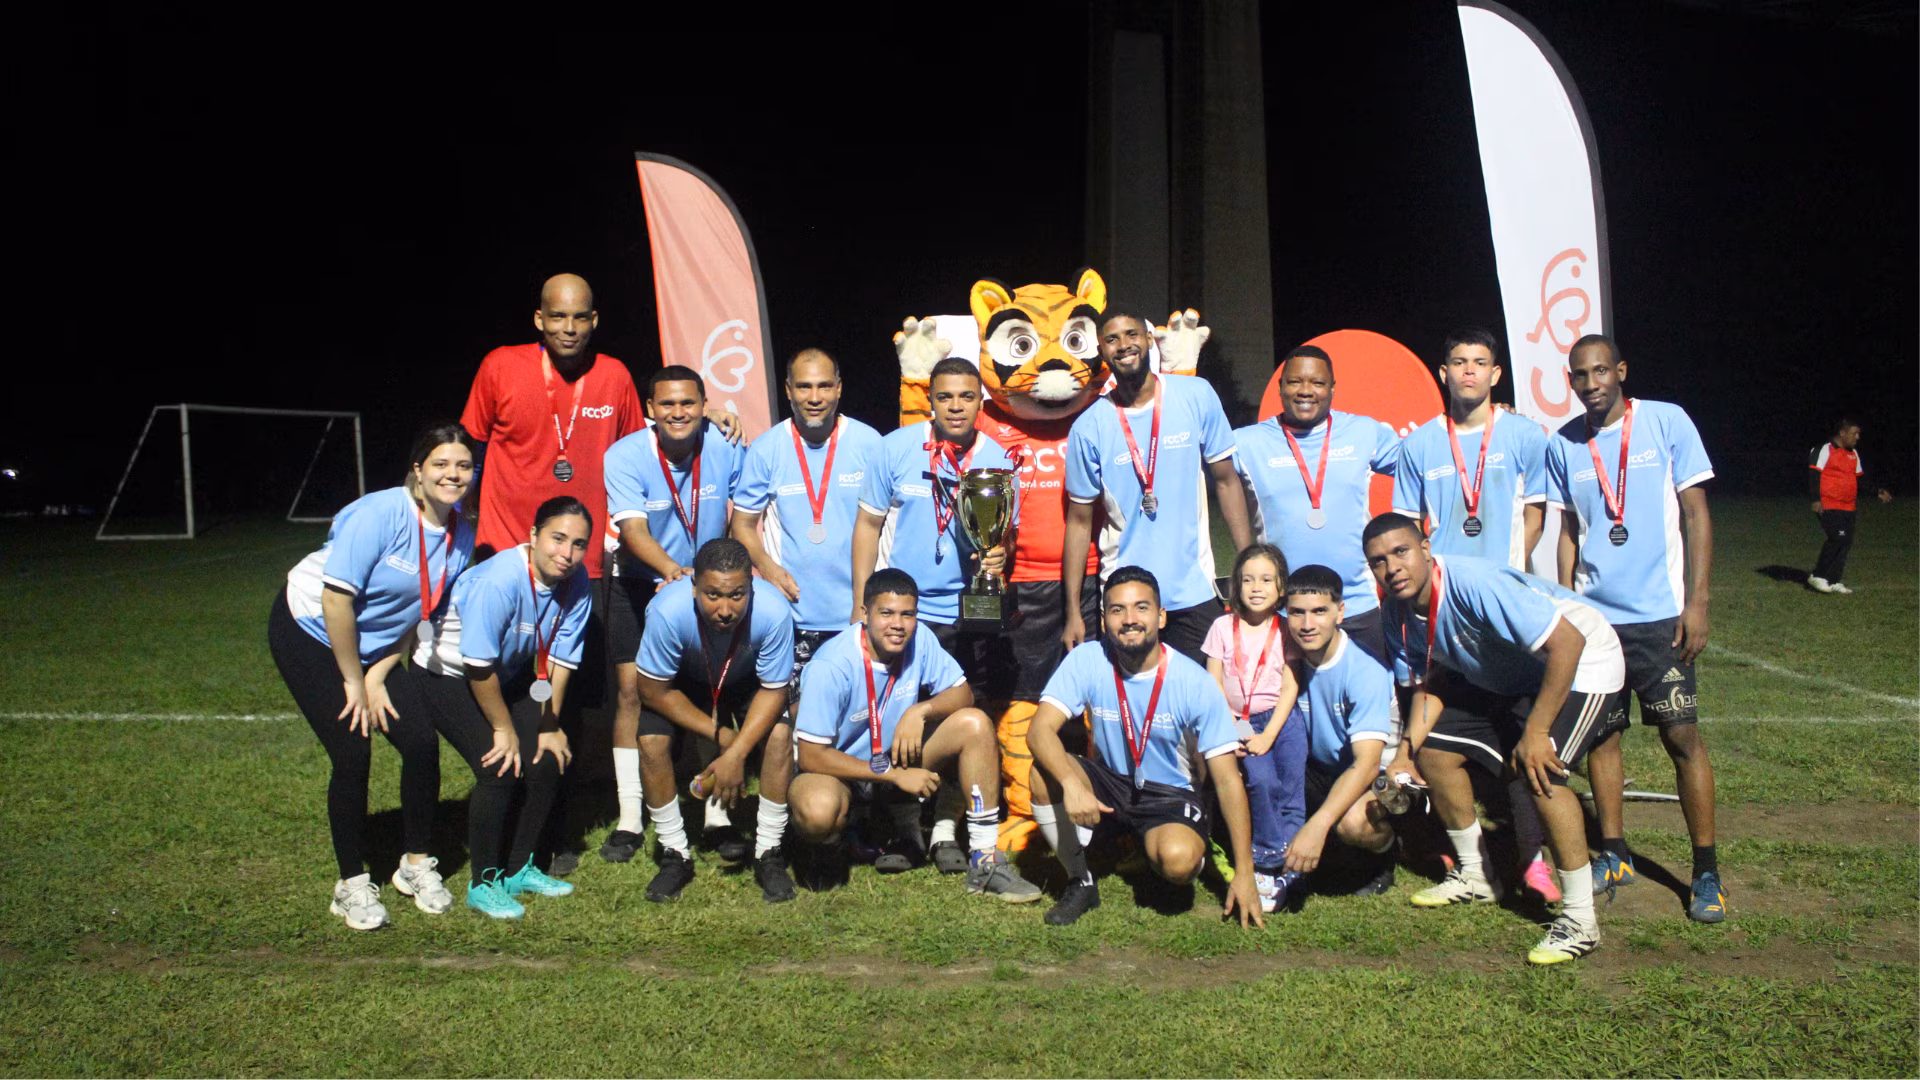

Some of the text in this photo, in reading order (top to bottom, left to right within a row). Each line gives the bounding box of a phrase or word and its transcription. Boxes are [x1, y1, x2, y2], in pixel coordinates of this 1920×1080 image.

[1017, 446, 1056, 473] CC
[1662, 675, 1685, 683] adidas
[1670, 685, 1685, 711] 6
